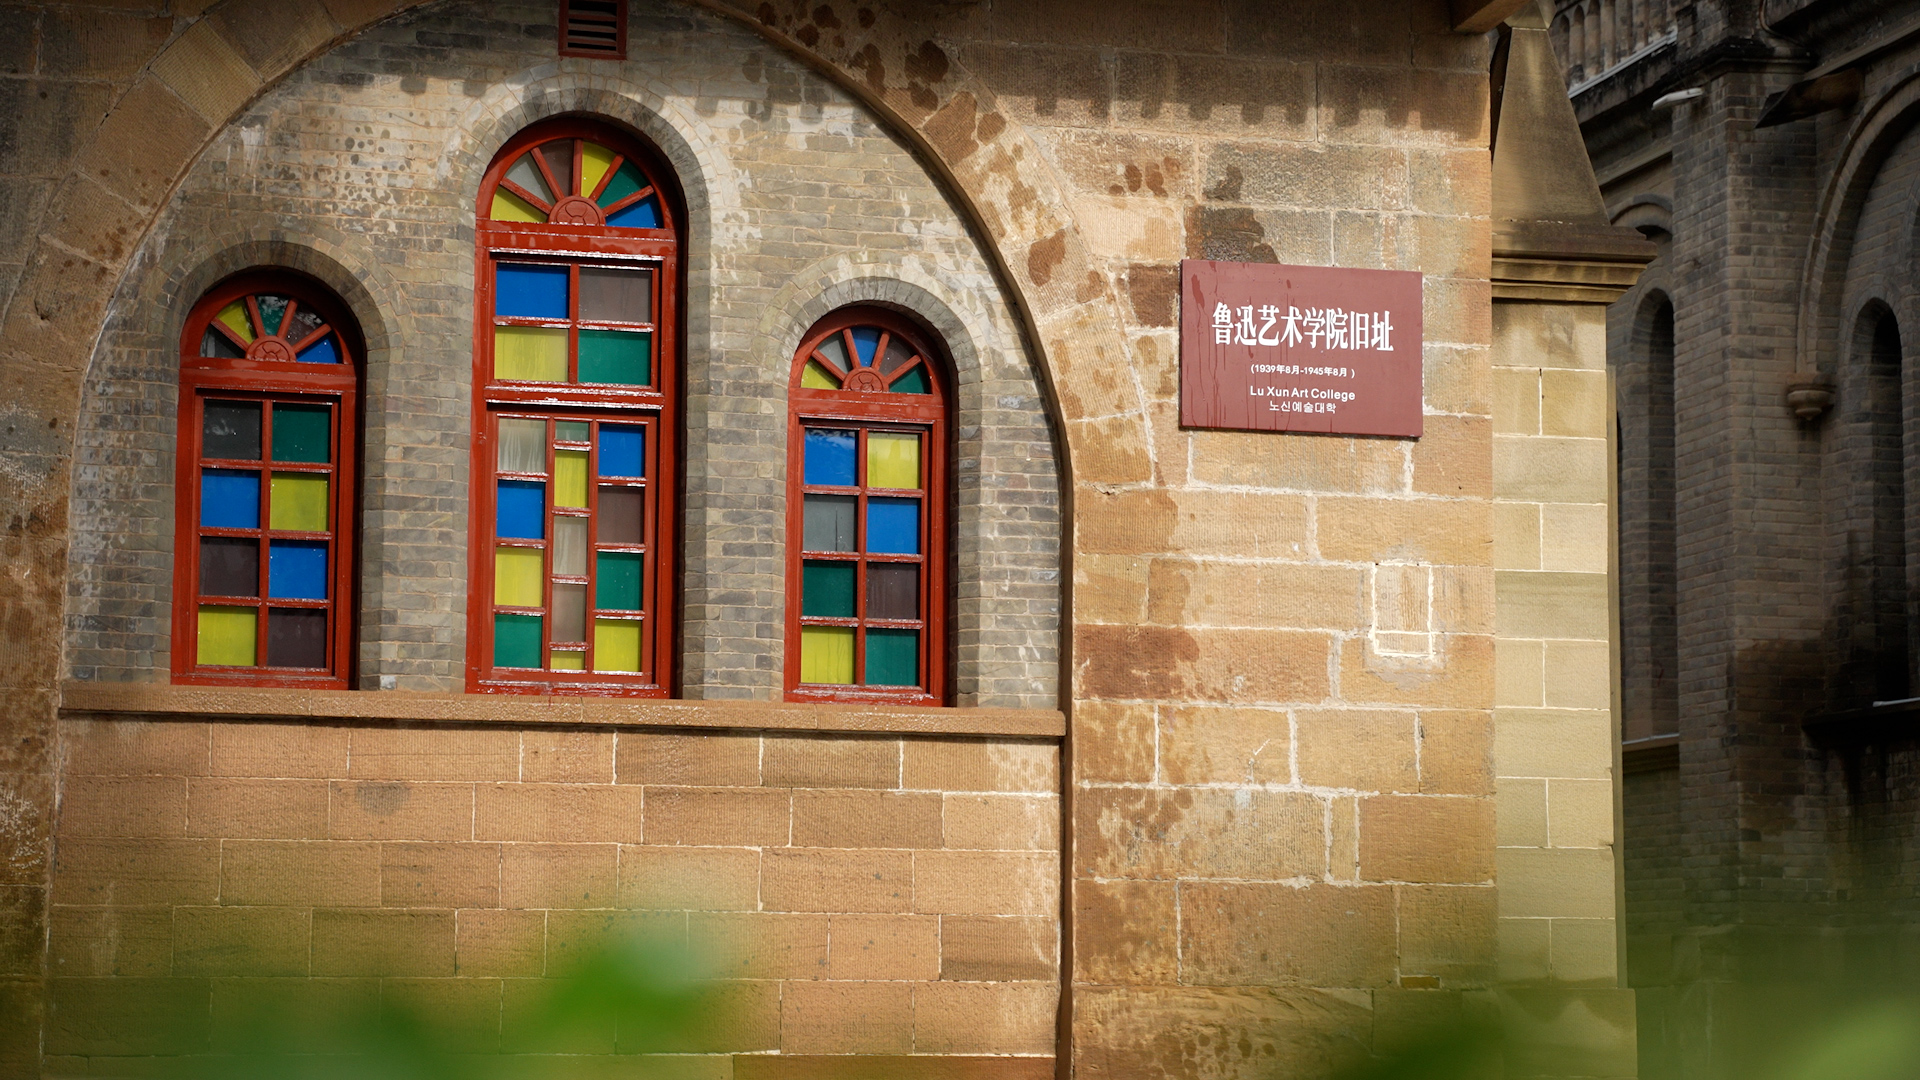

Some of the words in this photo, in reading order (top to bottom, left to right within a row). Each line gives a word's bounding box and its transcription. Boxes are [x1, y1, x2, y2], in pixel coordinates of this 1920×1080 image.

[1211, 301, 1394, 352] 鲁迅艺术学院旧址
[1250, 385, 1264, 396] Lu
[1267, 386, 1289, 397] Xun
[1291, 387, 1308, 398] Art
[1311, 388, 1356, 402] College
[1269, 401, 1337, 414] 노신예술대학
